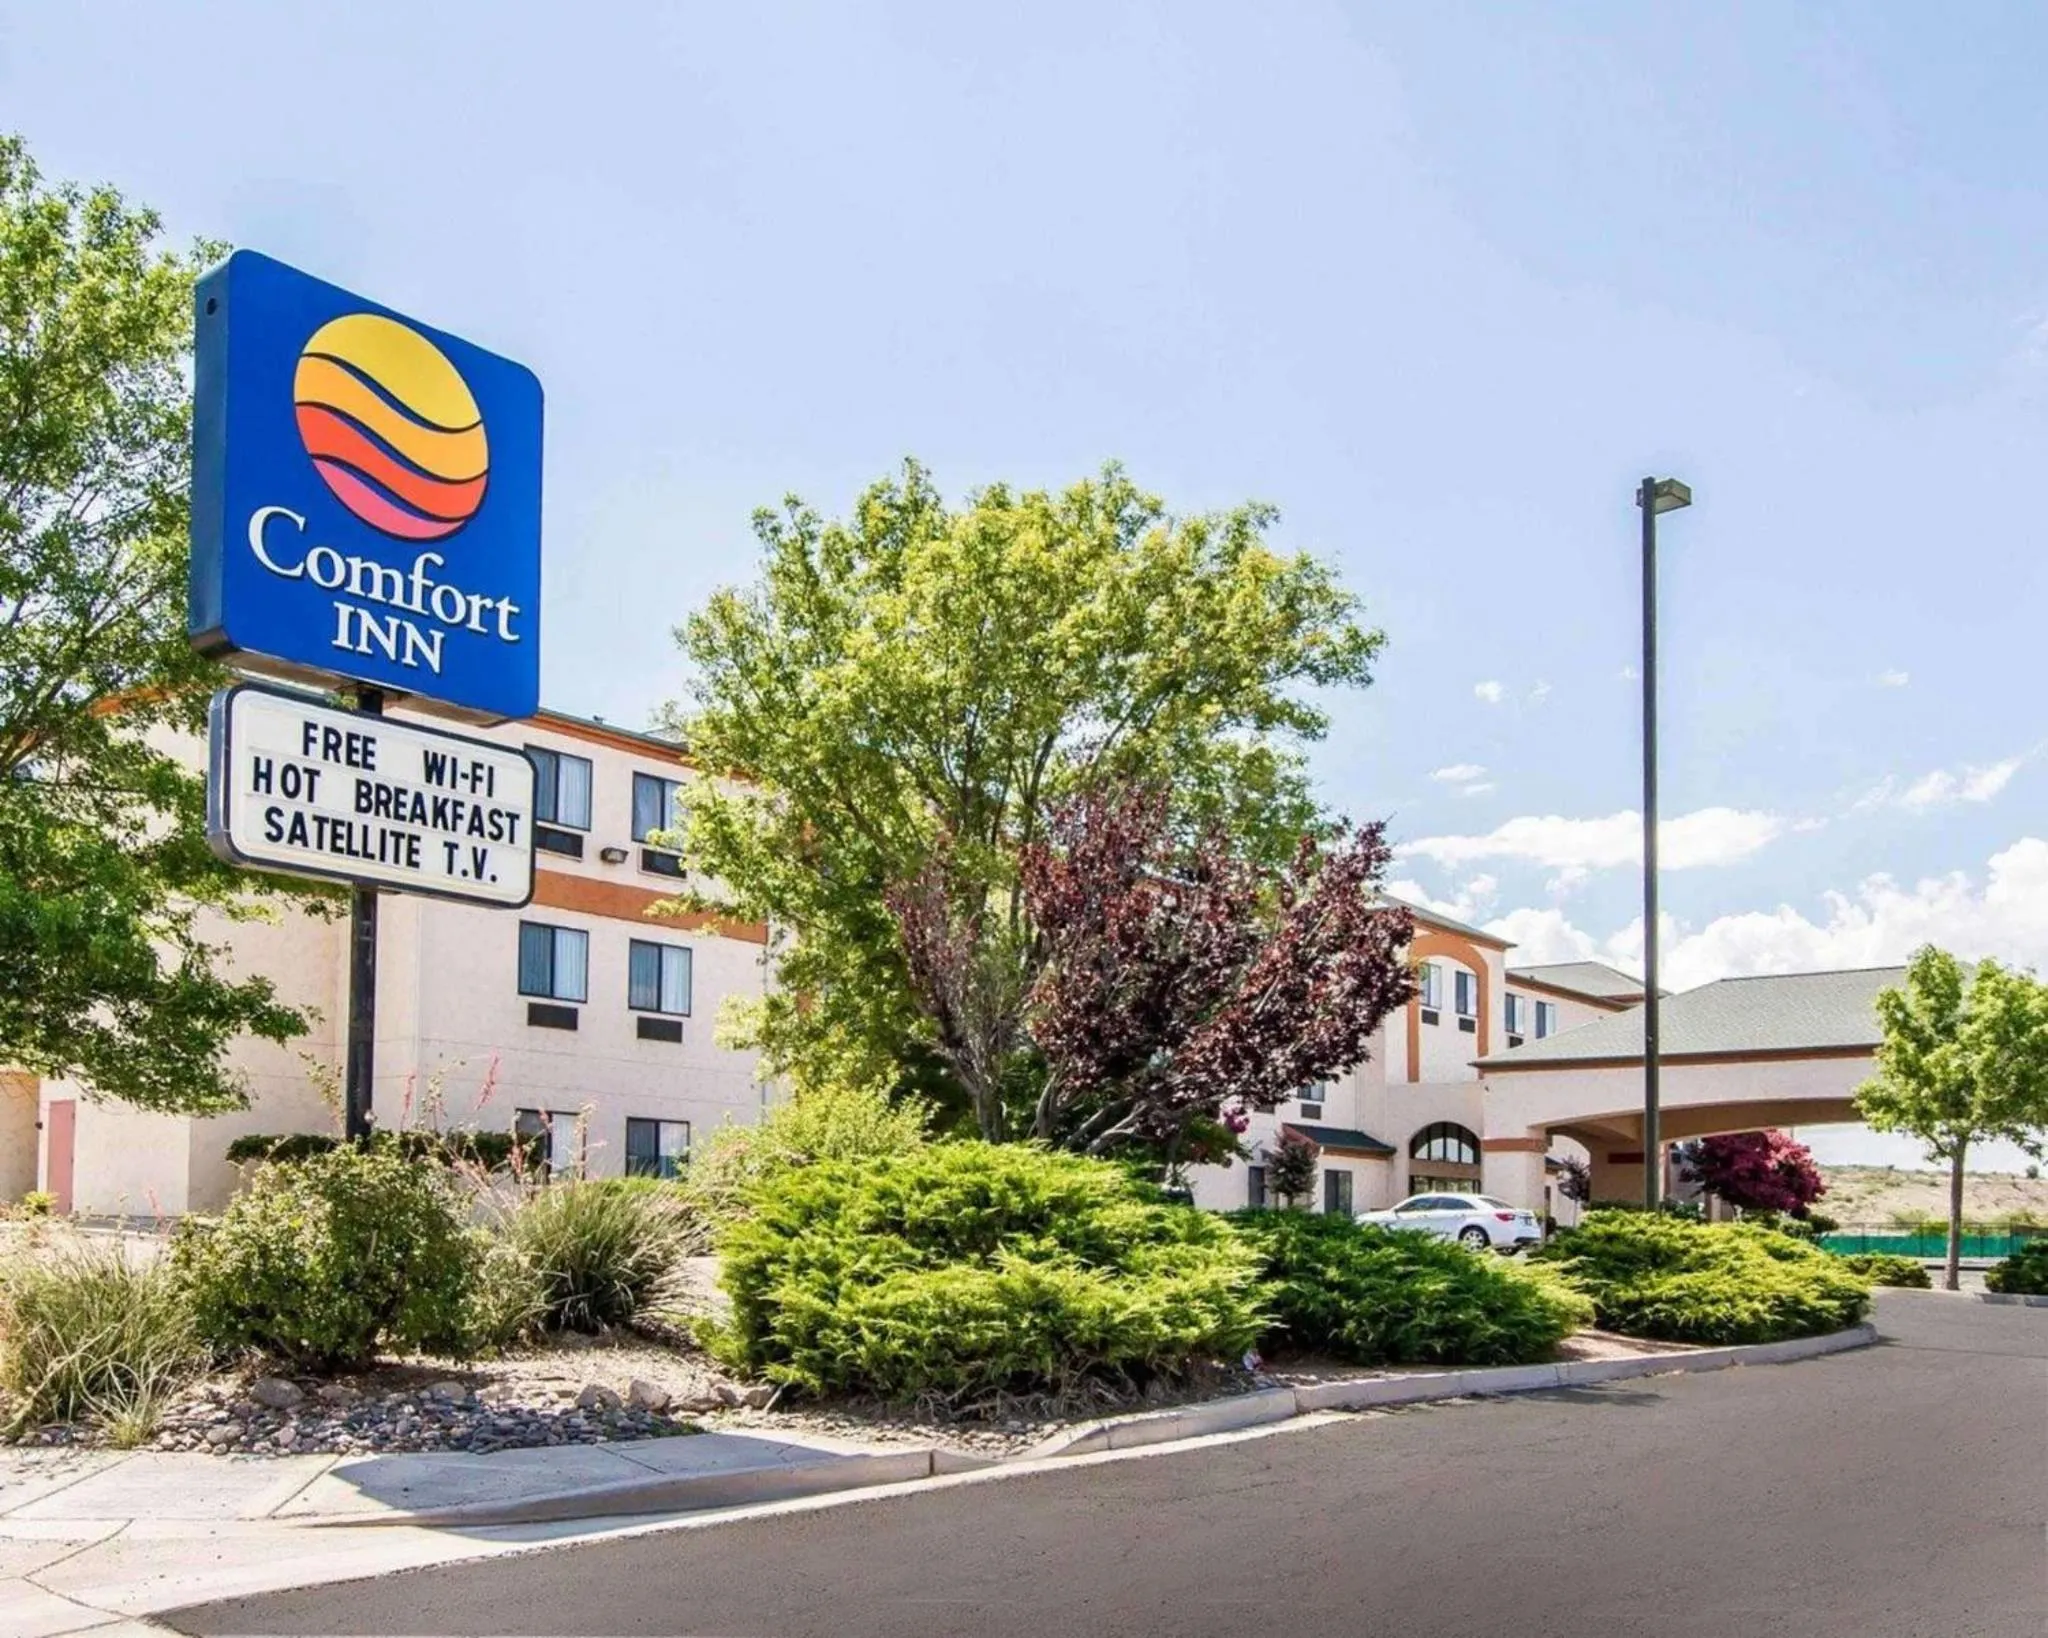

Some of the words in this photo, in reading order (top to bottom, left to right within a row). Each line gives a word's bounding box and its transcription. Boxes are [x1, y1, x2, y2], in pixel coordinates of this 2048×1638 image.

[248, 505, 520, 641] Comfort
[332, 601, 445, 674] INN
[303, 721, 377, 772] FREE
[423, 749, 495, 798] WI-FI
[253, 756, 321, 803] HOT
[355, 778, 520, 844] BREAKFAST
[264, 806, 421, 869] SATELLITE
[443, 841, 498, 884] T.V.
